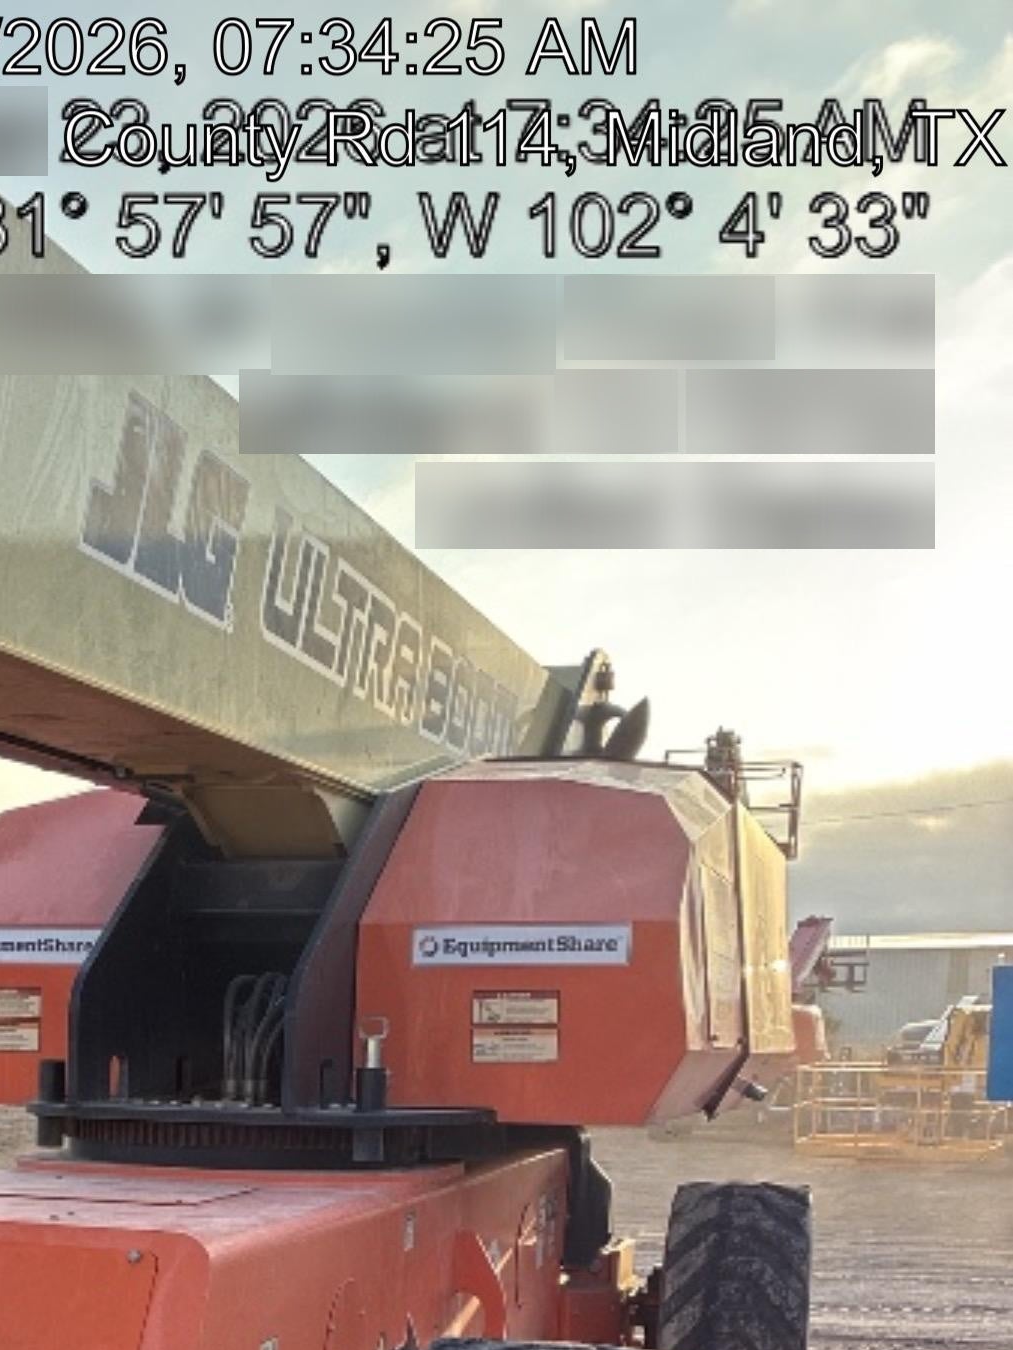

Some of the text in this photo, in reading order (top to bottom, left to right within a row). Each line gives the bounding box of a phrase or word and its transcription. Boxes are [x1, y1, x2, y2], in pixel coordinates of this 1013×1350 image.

[78, 390, 252, 634] JLG
[260, 504, 425, 728] ULTRA
[443, 935, 619, 957] EquipmentShare
